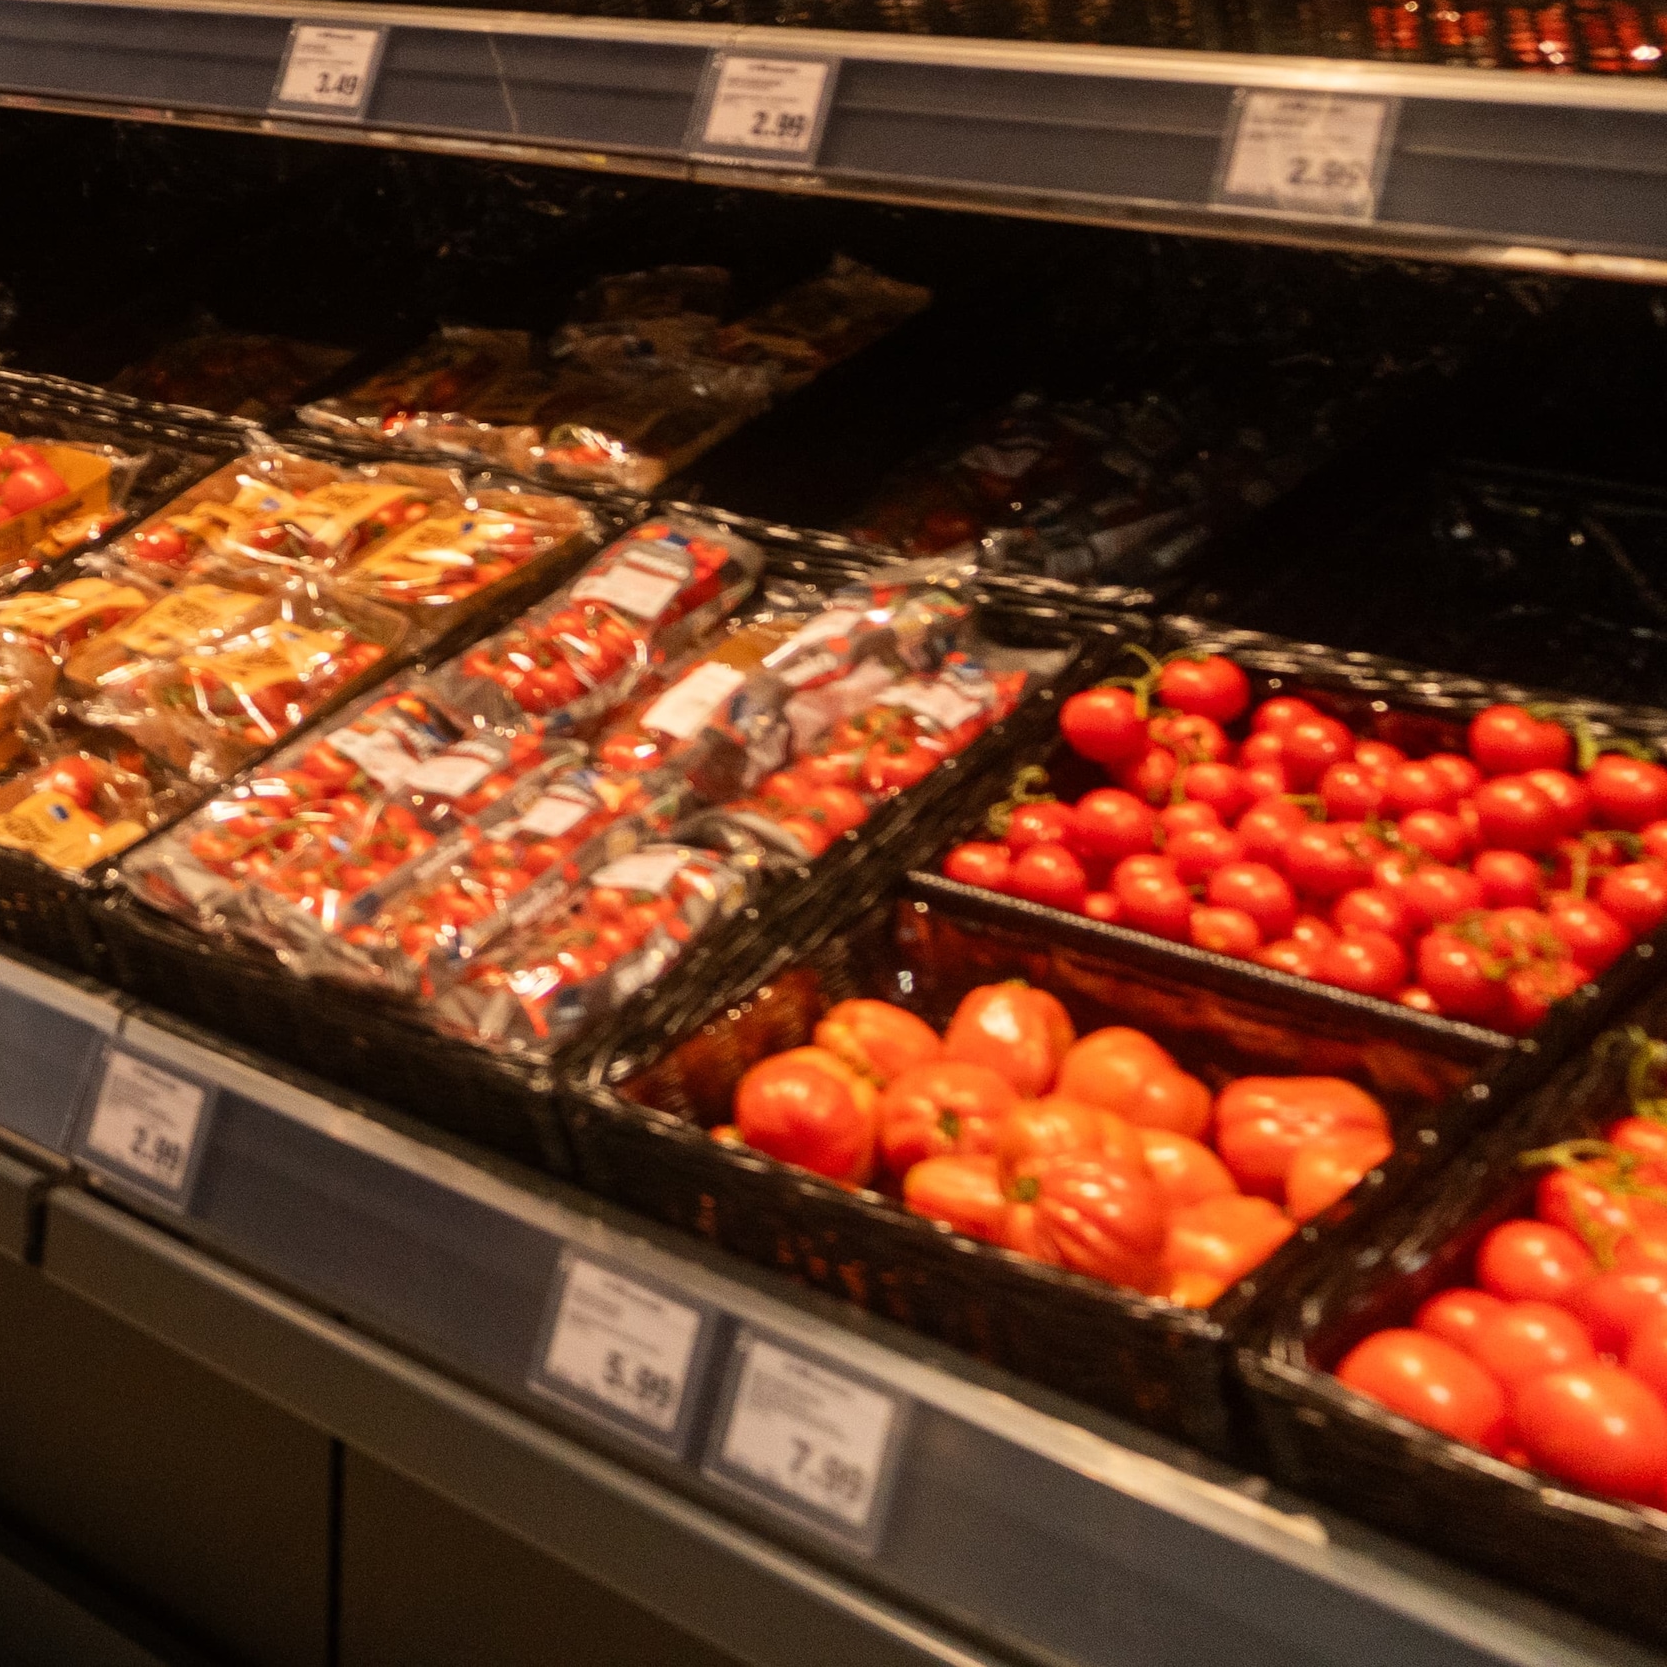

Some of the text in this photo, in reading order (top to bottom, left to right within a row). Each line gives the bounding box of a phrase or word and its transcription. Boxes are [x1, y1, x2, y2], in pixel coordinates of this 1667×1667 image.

[750, 107, 806, 141] 2.99
[1287, 155, 1369, 194] 2.99
[789, 1437, 864, 1503] 7.99
